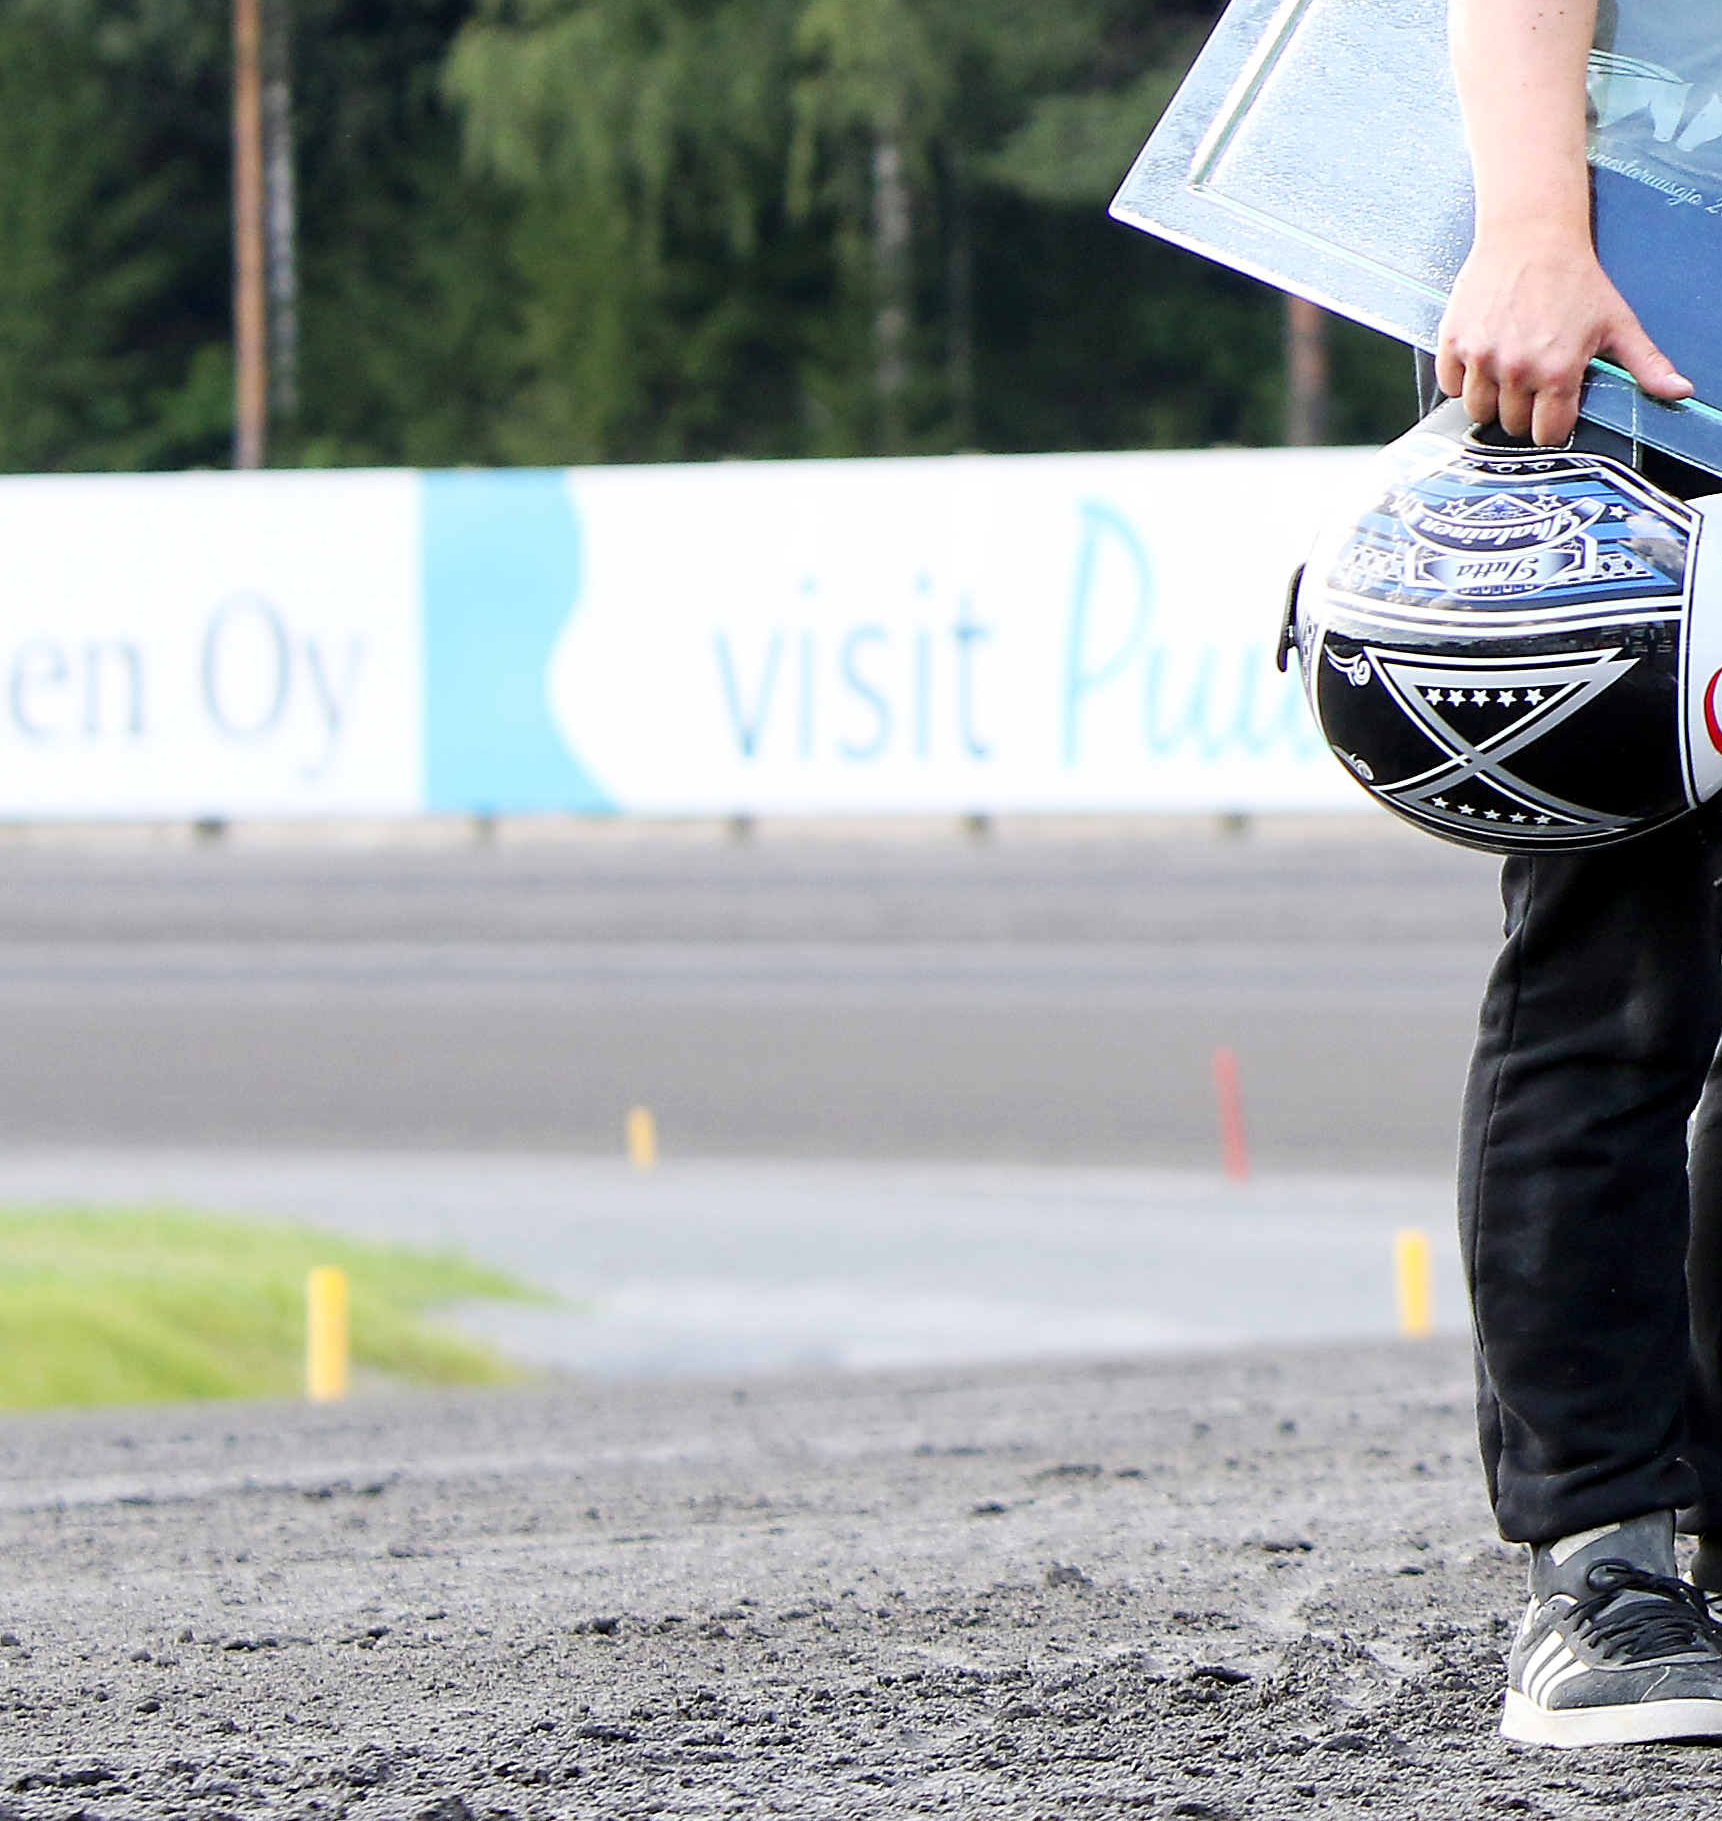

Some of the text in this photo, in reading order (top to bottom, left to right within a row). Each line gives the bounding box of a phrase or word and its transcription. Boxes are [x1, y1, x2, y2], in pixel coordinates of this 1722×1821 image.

[1457, 557, 1539, 583] Jutta
[200, 590, 364, 782] Oy
[712, 571, 996, 765] visit
